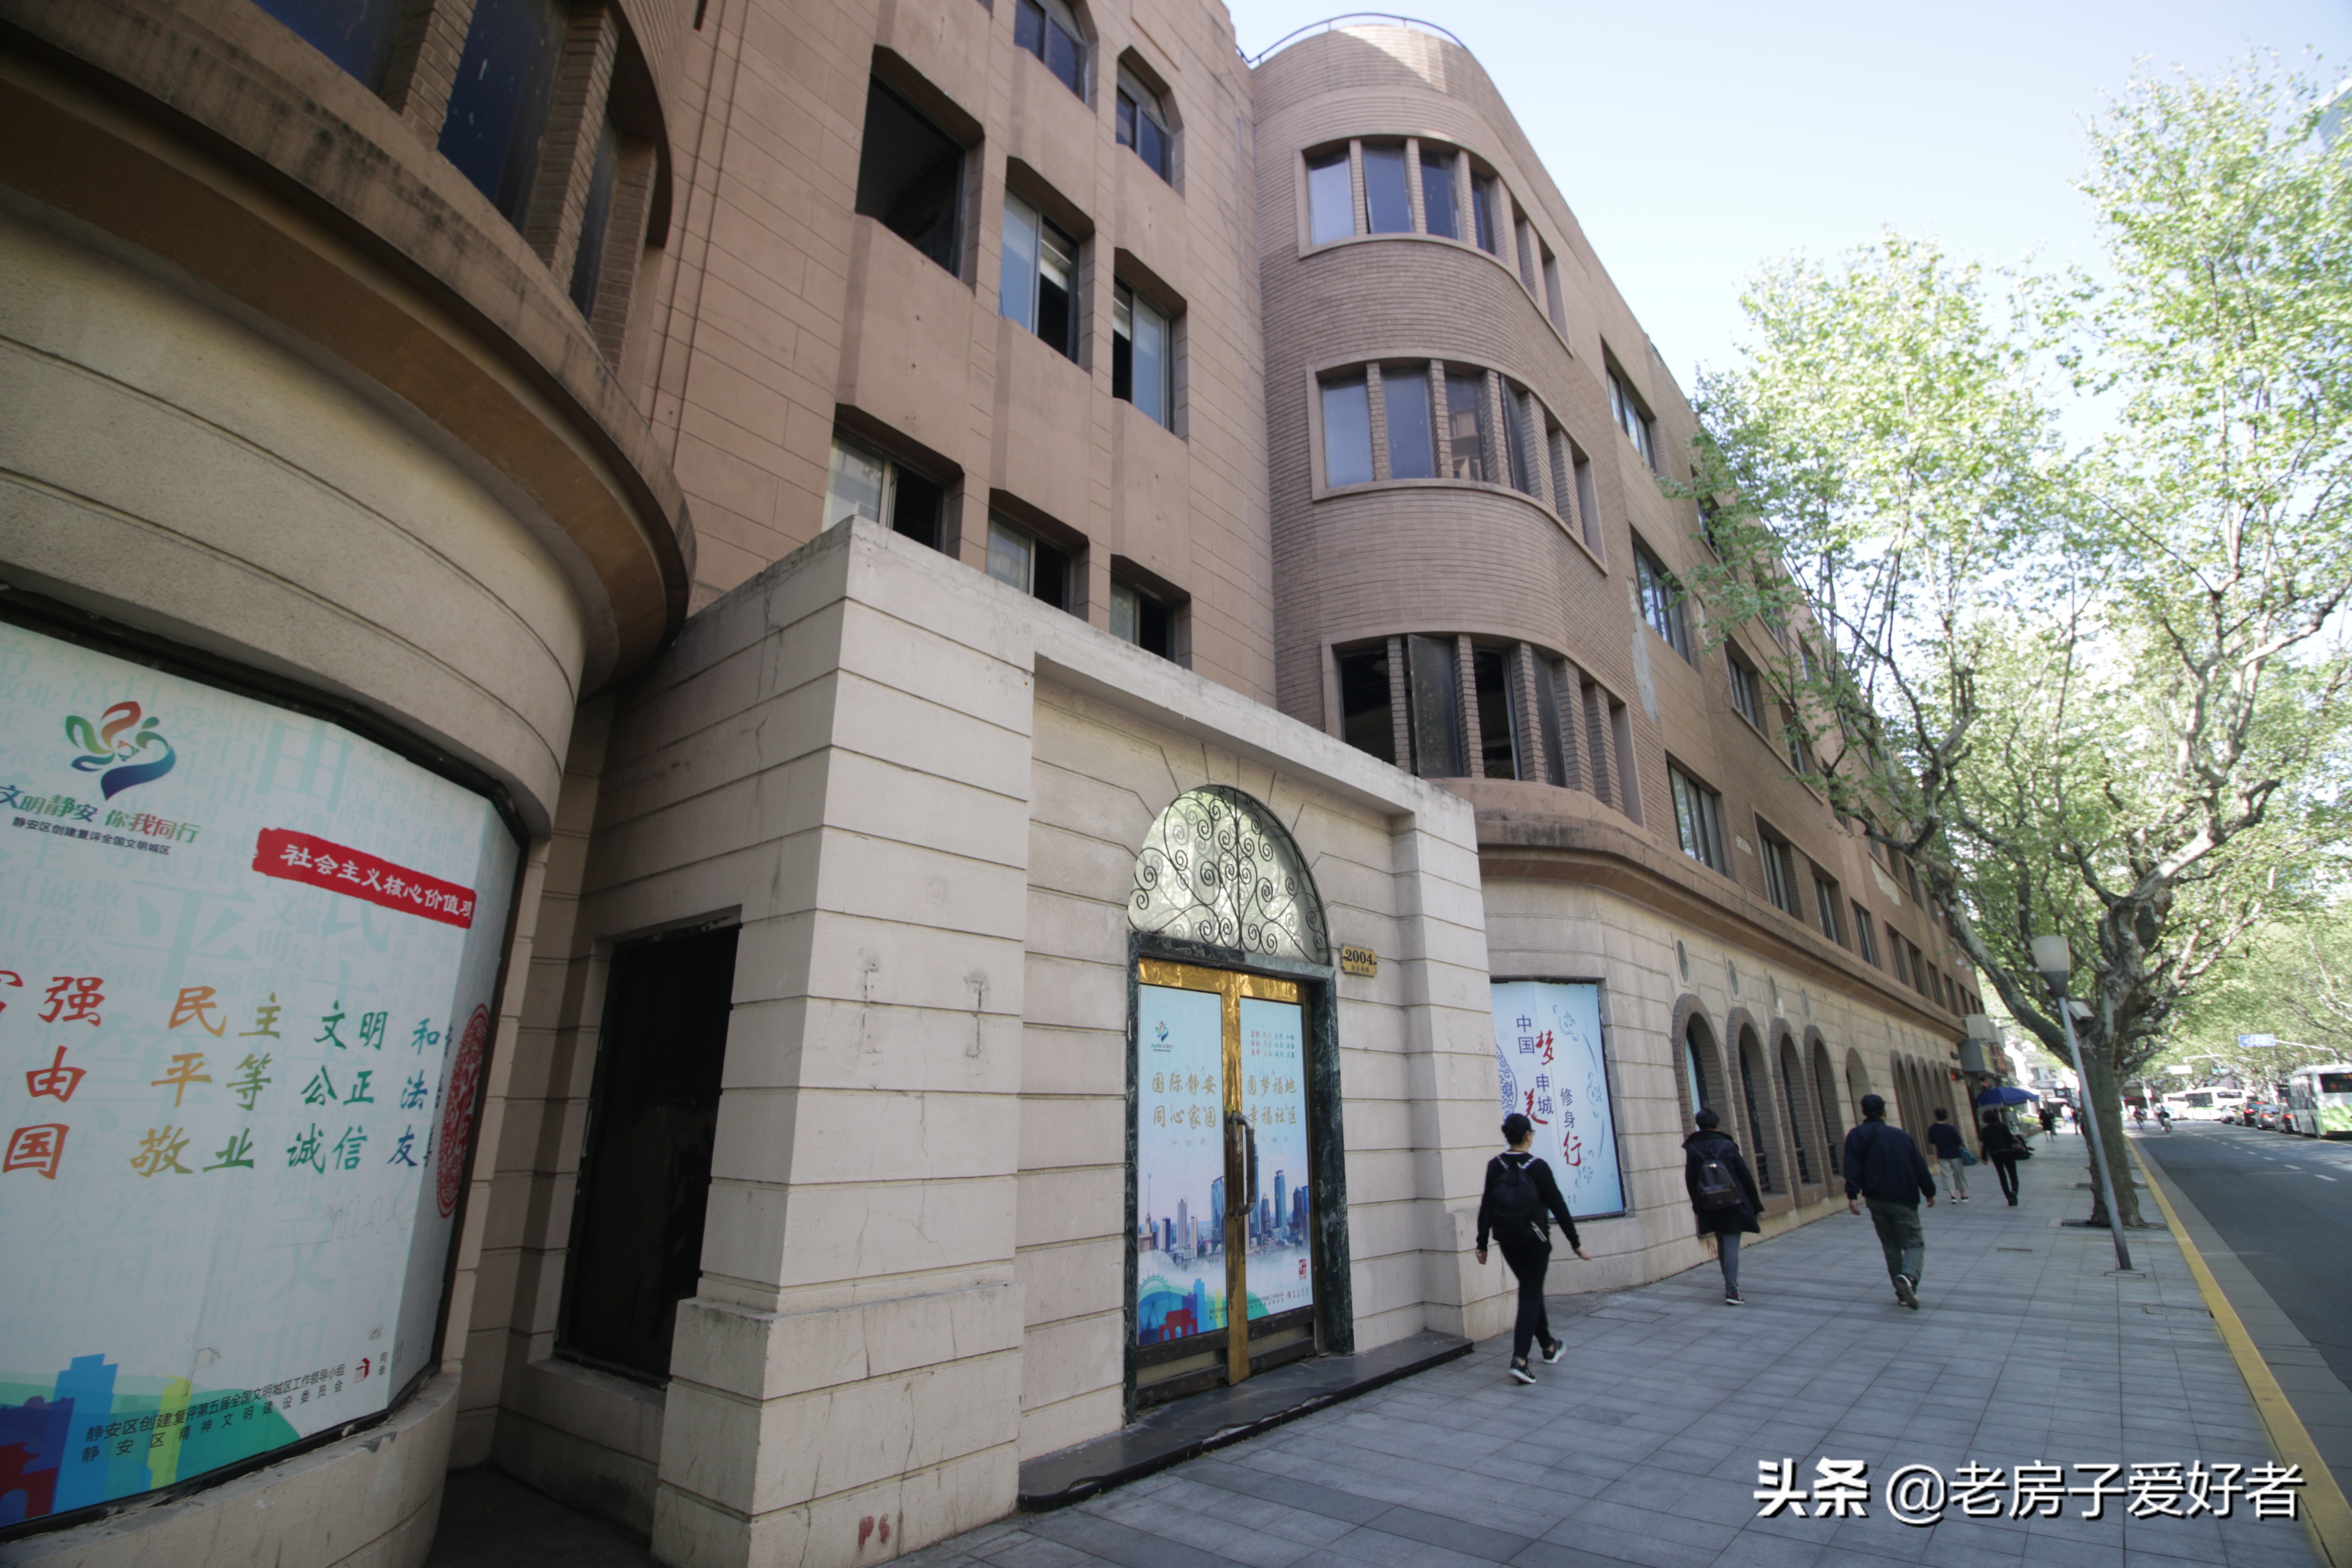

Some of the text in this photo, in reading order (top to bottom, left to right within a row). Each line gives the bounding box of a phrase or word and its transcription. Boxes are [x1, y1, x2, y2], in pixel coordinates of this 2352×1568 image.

[0, 784, 202, 843] 文明静安 你我同行
[12, 816, 171, 855] 静安区创建复评全国文明城区
[1345, 949, 1373, 965] 2004
[168, 986, 281, 1039] 民主
[314, 1000, 388, 1050] 文明
[151, 1051, 272, 1111] 平等
[301, 1065, 374, 1106] 公正
[1152, 1072, 1216, 1096] 国际静安
[130, 1125, 254, 1178] 敬业
[287, 1123, 368, 1174] 诚信
[81, 1378, 343, 1463] 静安区精神文明建设委员会
[85, 1363, 346, 1444] 静安区创建复评第五届全国文明城区工作领导小组
